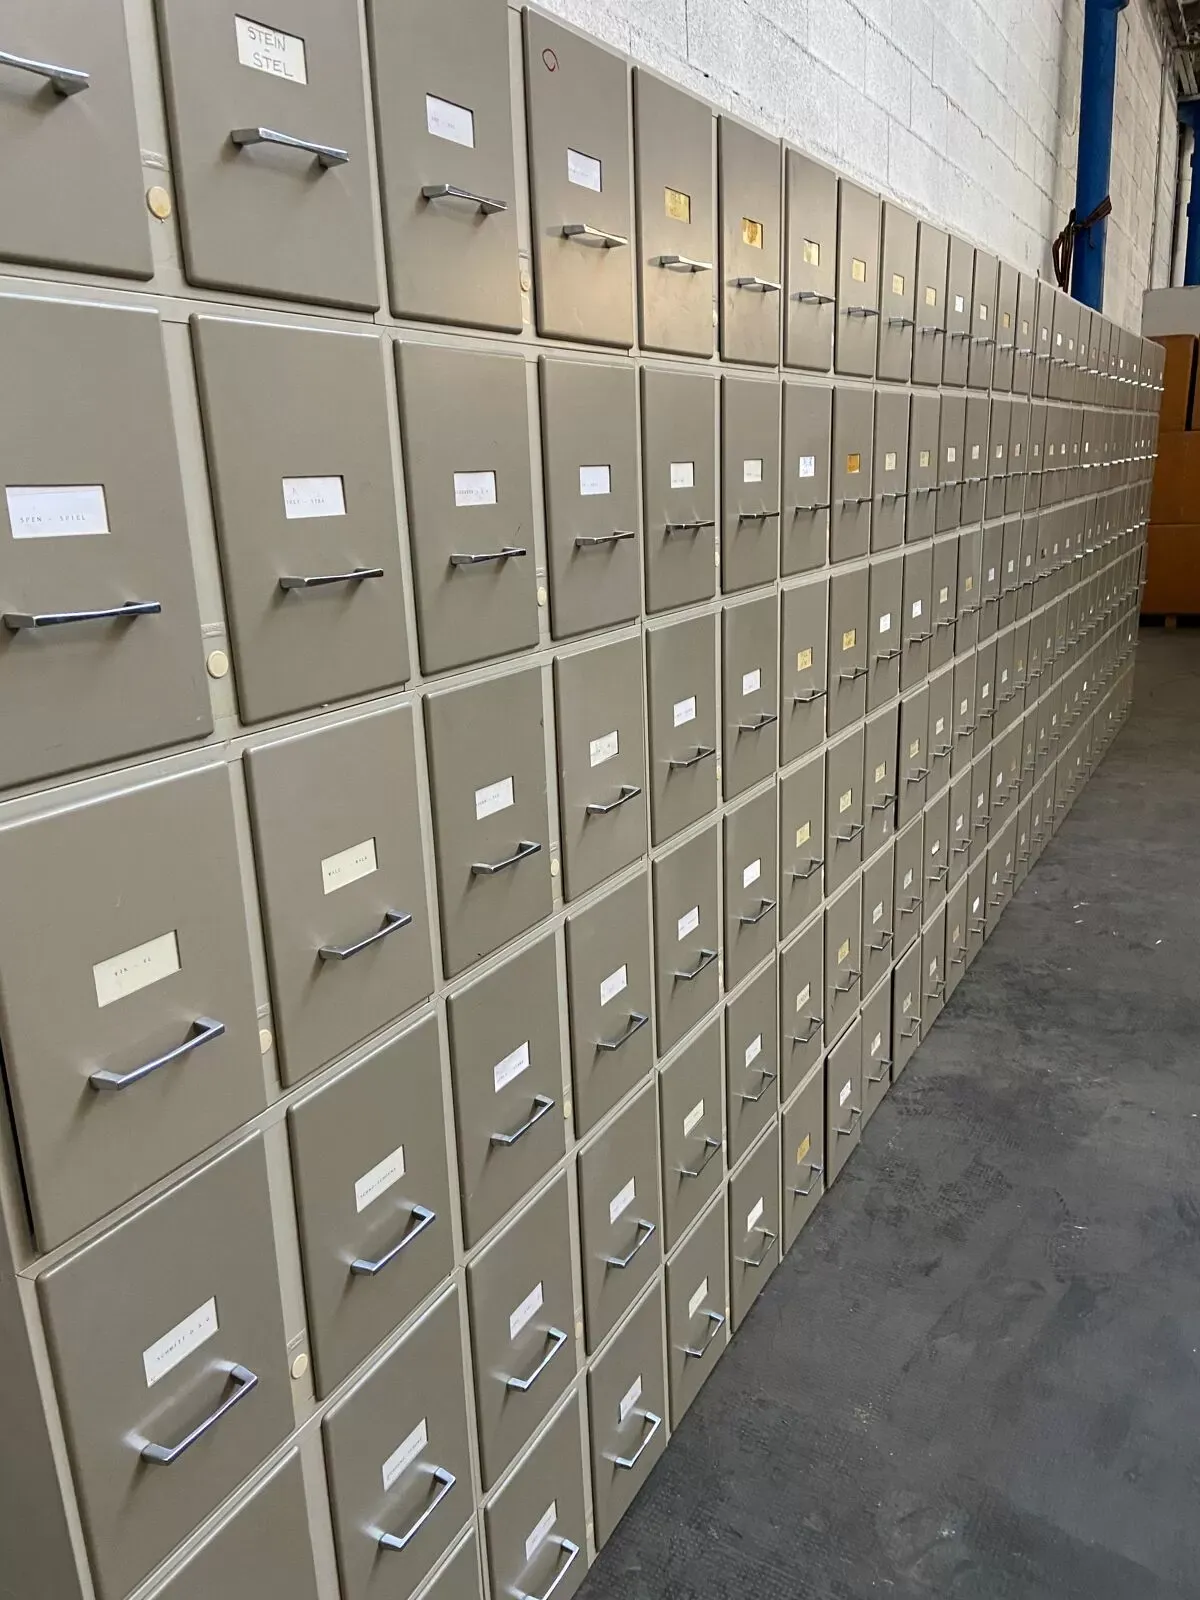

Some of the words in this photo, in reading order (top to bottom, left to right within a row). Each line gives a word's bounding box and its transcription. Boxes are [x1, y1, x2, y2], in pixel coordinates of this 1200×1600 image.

[247, 26, 286, 52] STEIN
[252, 52, 294, 77] STEL
[20, 516, 43, 524] SPEN
[59, 514, 86, 522] SPIEL
